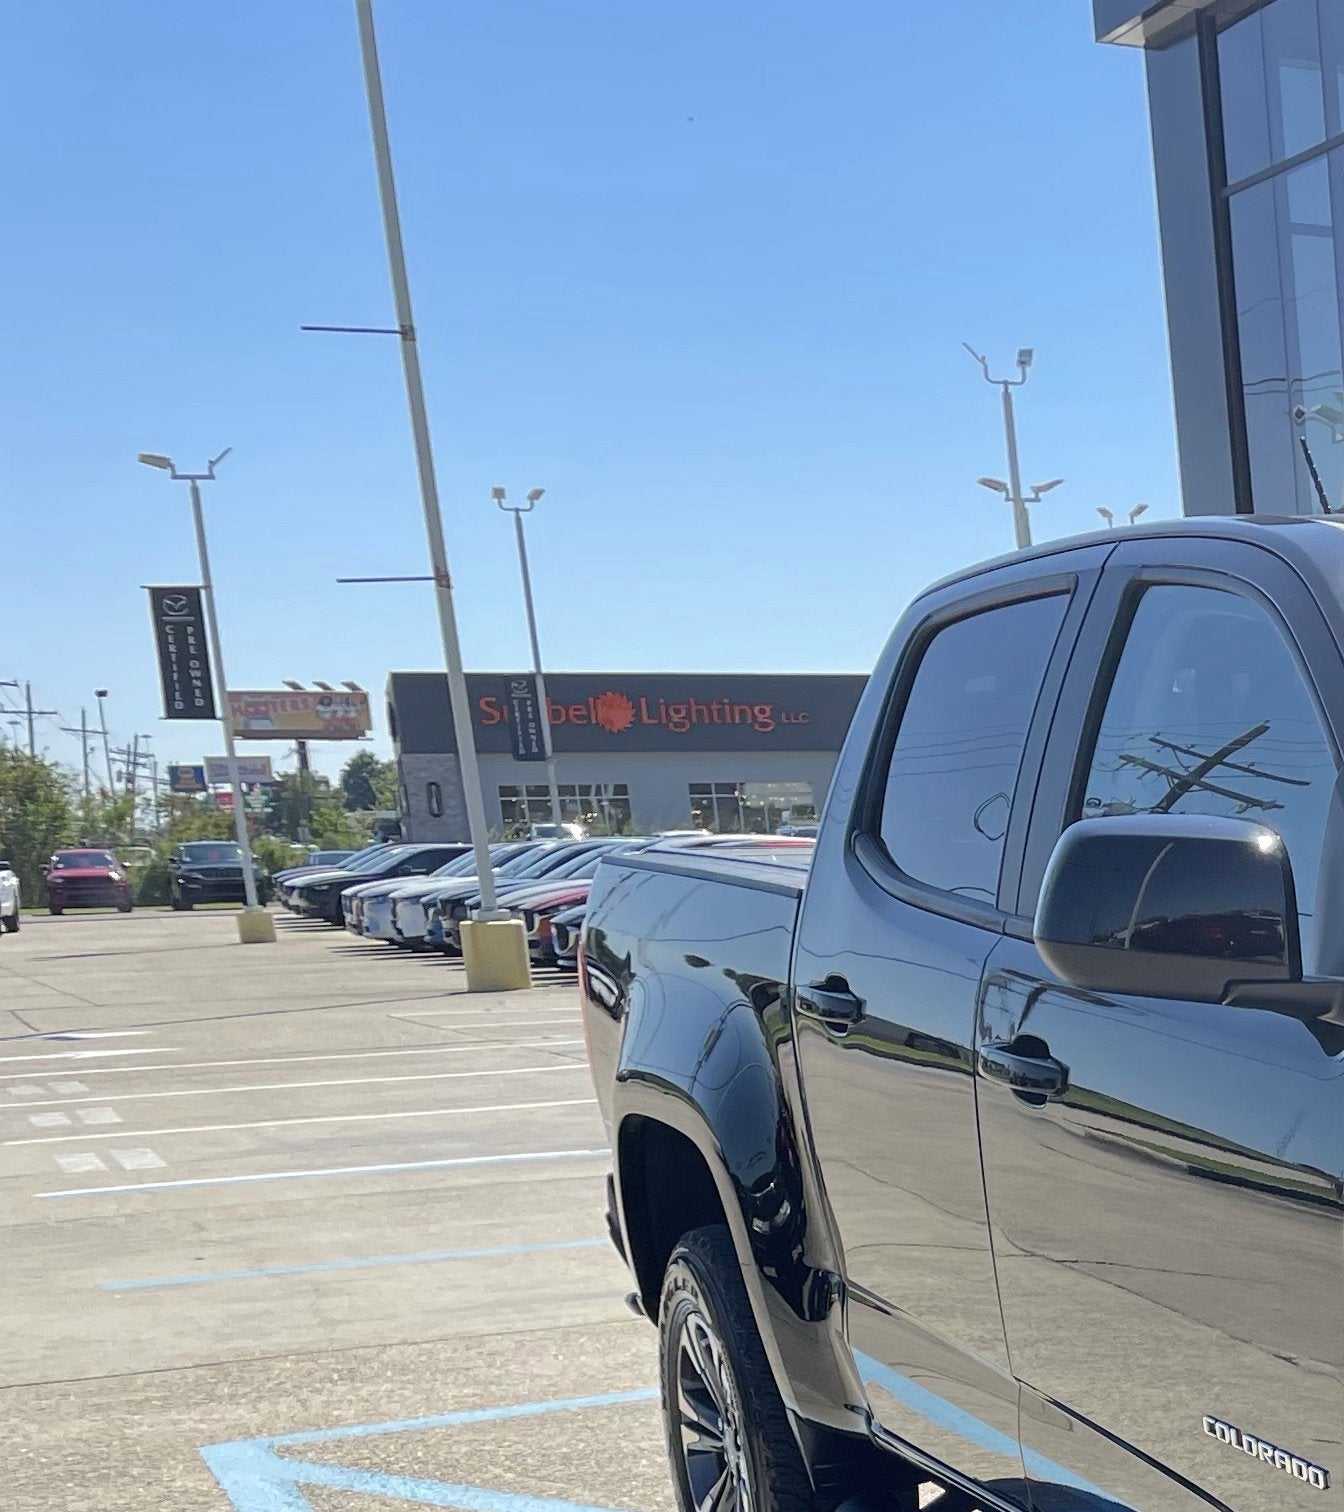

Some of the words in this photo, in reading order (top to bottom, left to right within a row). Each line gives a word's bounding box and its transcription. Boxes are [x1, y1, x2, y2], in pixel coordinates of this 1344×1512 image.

[187, 625, 199, 655] PRE
[189, 659, 204, 707] OWNED
[640, 698, 775, 732] Lighting
[781, 711, 809, 723] LLC
[1203, 1415, 1330, 1490] COLORADO
